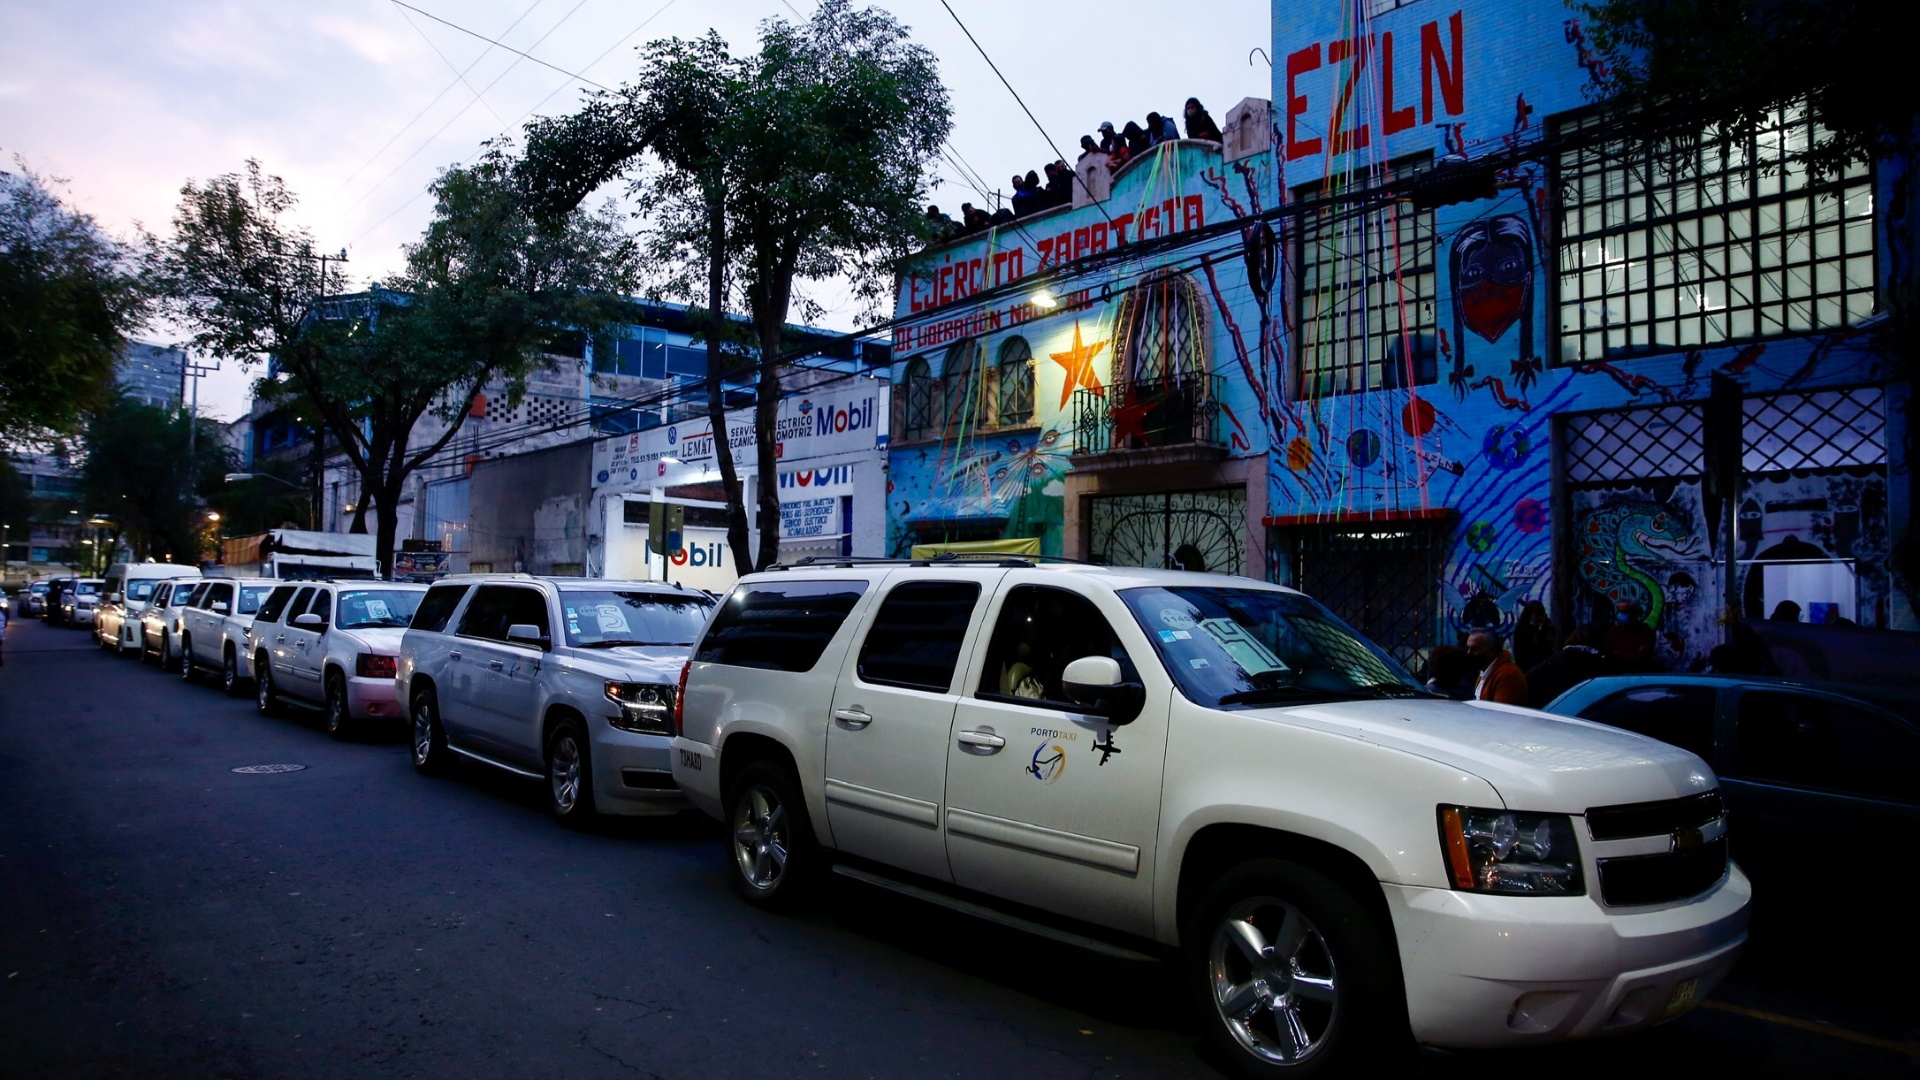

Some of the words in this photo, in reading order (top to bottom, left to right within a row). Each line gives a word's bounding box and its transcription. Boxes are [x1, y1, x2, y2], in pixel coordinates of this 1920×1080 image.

[1286, 9, 1464, 162] EZLN
[1037, 194, 1204, 273] ZAPATISTA
[895, 327, 913, 352] DE
[816, 397, 873, 437] Mobil
[645, 539, 722, 567] obil
[598, 607, 624, 628] 5
[1030, 727, 1077, 742] PORTOTAXI
